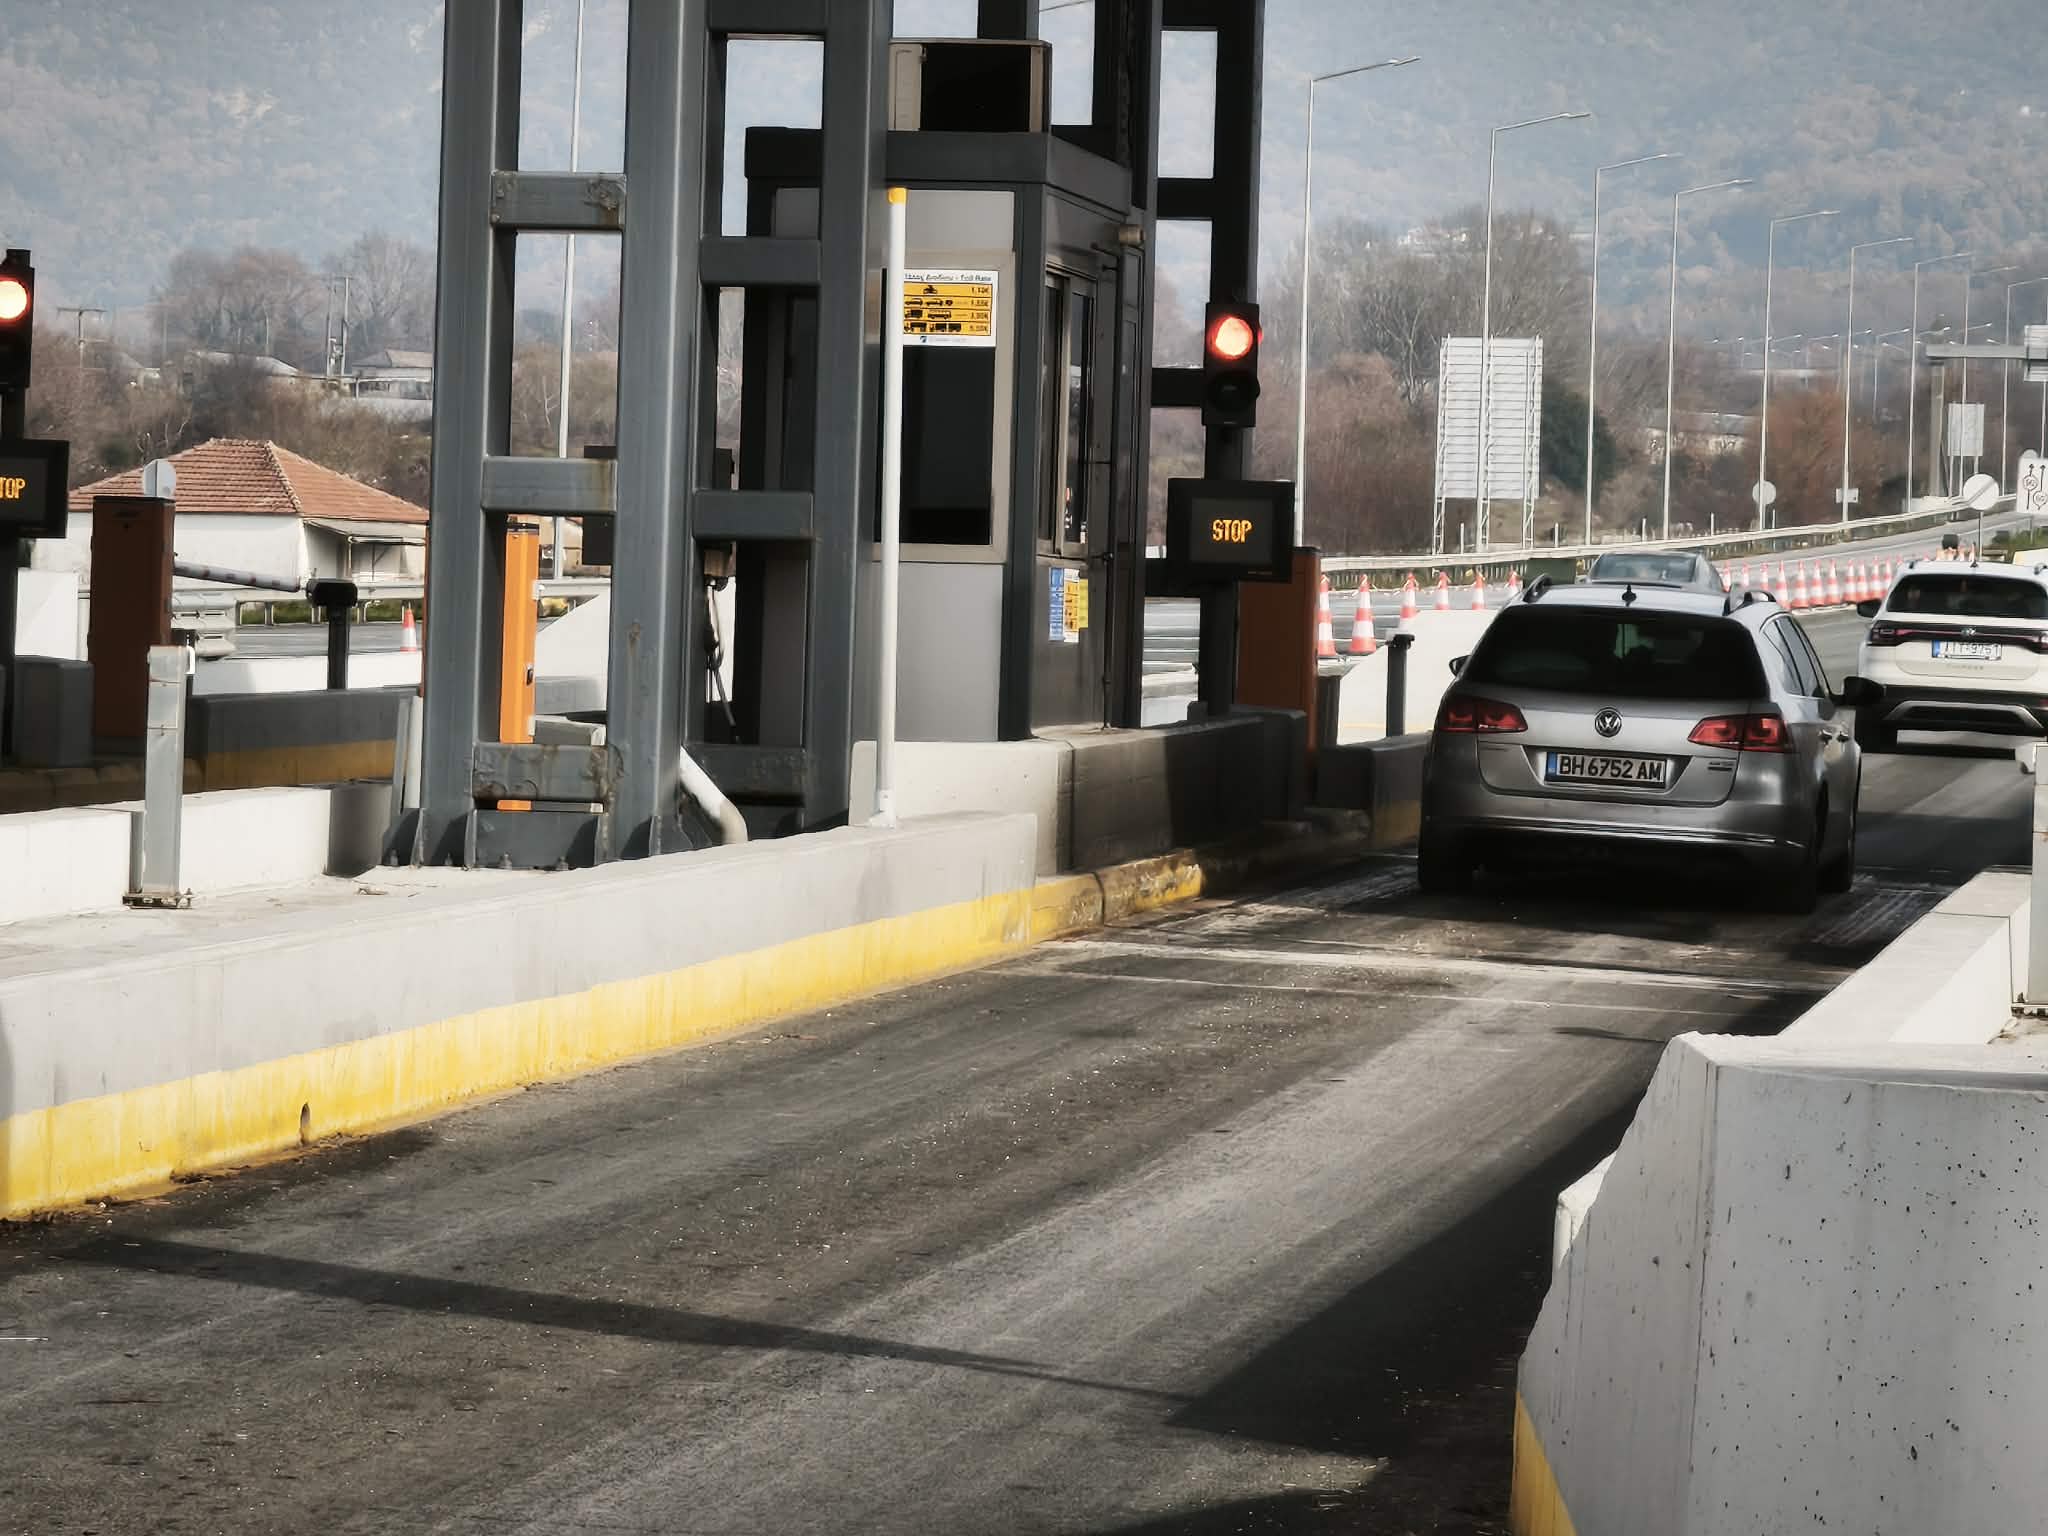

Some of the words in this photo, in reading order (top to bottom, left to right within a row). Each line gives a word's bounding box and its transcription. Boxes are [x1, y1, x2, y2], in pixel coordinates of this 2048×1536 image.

[0, 476, 26, 499] TOP
[1212, 519, 1252, 543] STOP
[1560, 755, 1585, 776] BH
[1587, 757, 1634, 778] 6752
[1636, 761, 1663, 781] AM
